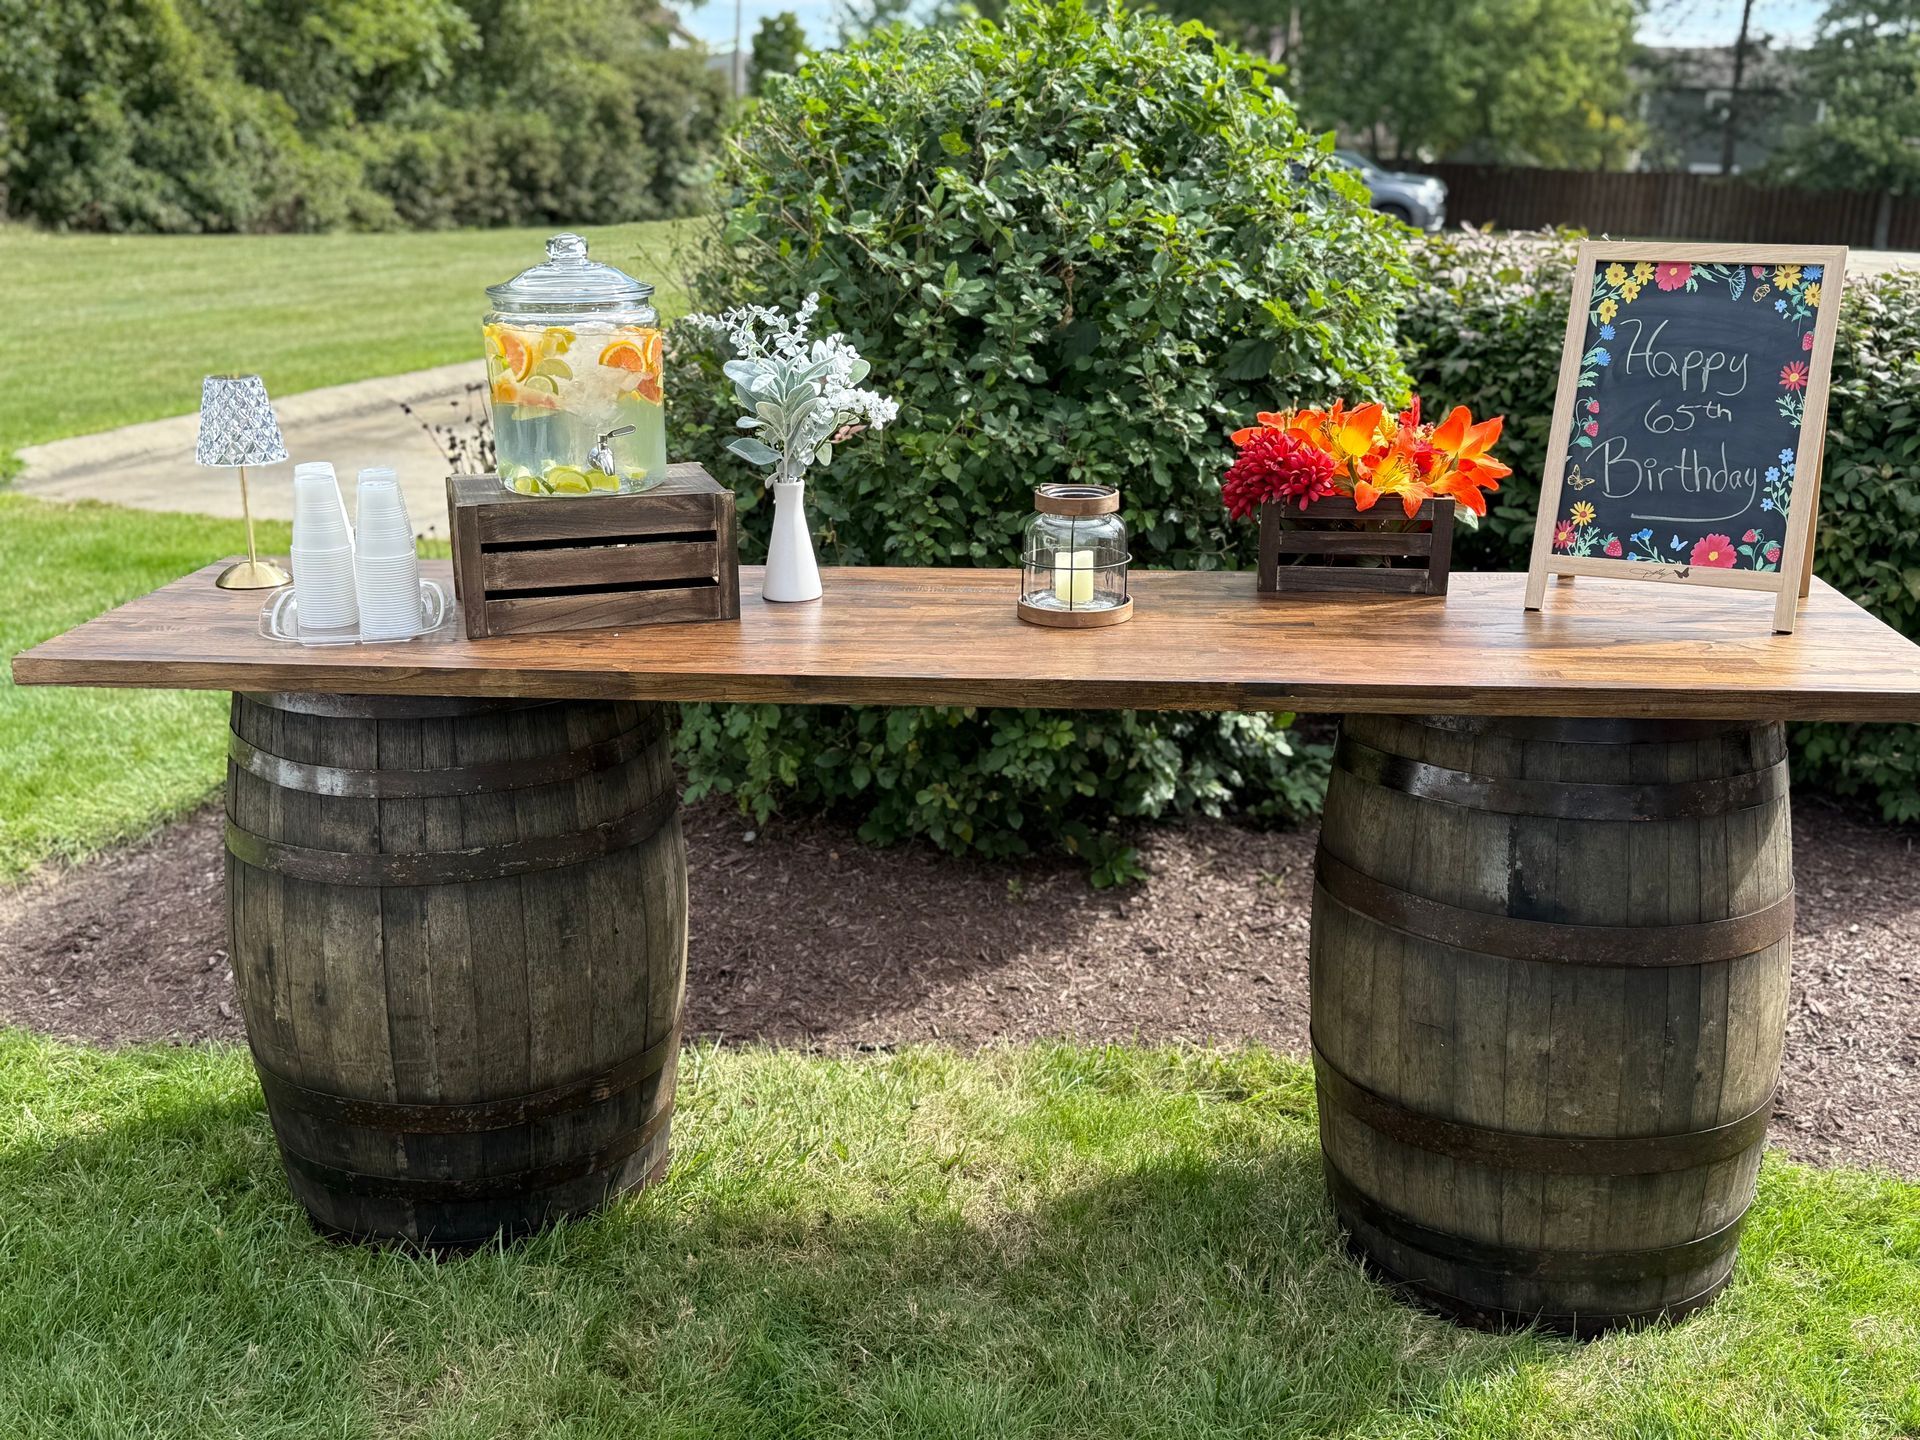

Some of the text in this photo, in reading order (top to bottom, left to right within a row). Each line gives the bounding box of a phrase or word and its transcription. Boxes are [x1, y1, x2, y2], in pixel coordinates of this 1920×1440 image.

[1620, 319, 1749, 396] Happy
[1645, 400, 1732, 434] 65th
[1585, 436, 1757, 522] Birthday
